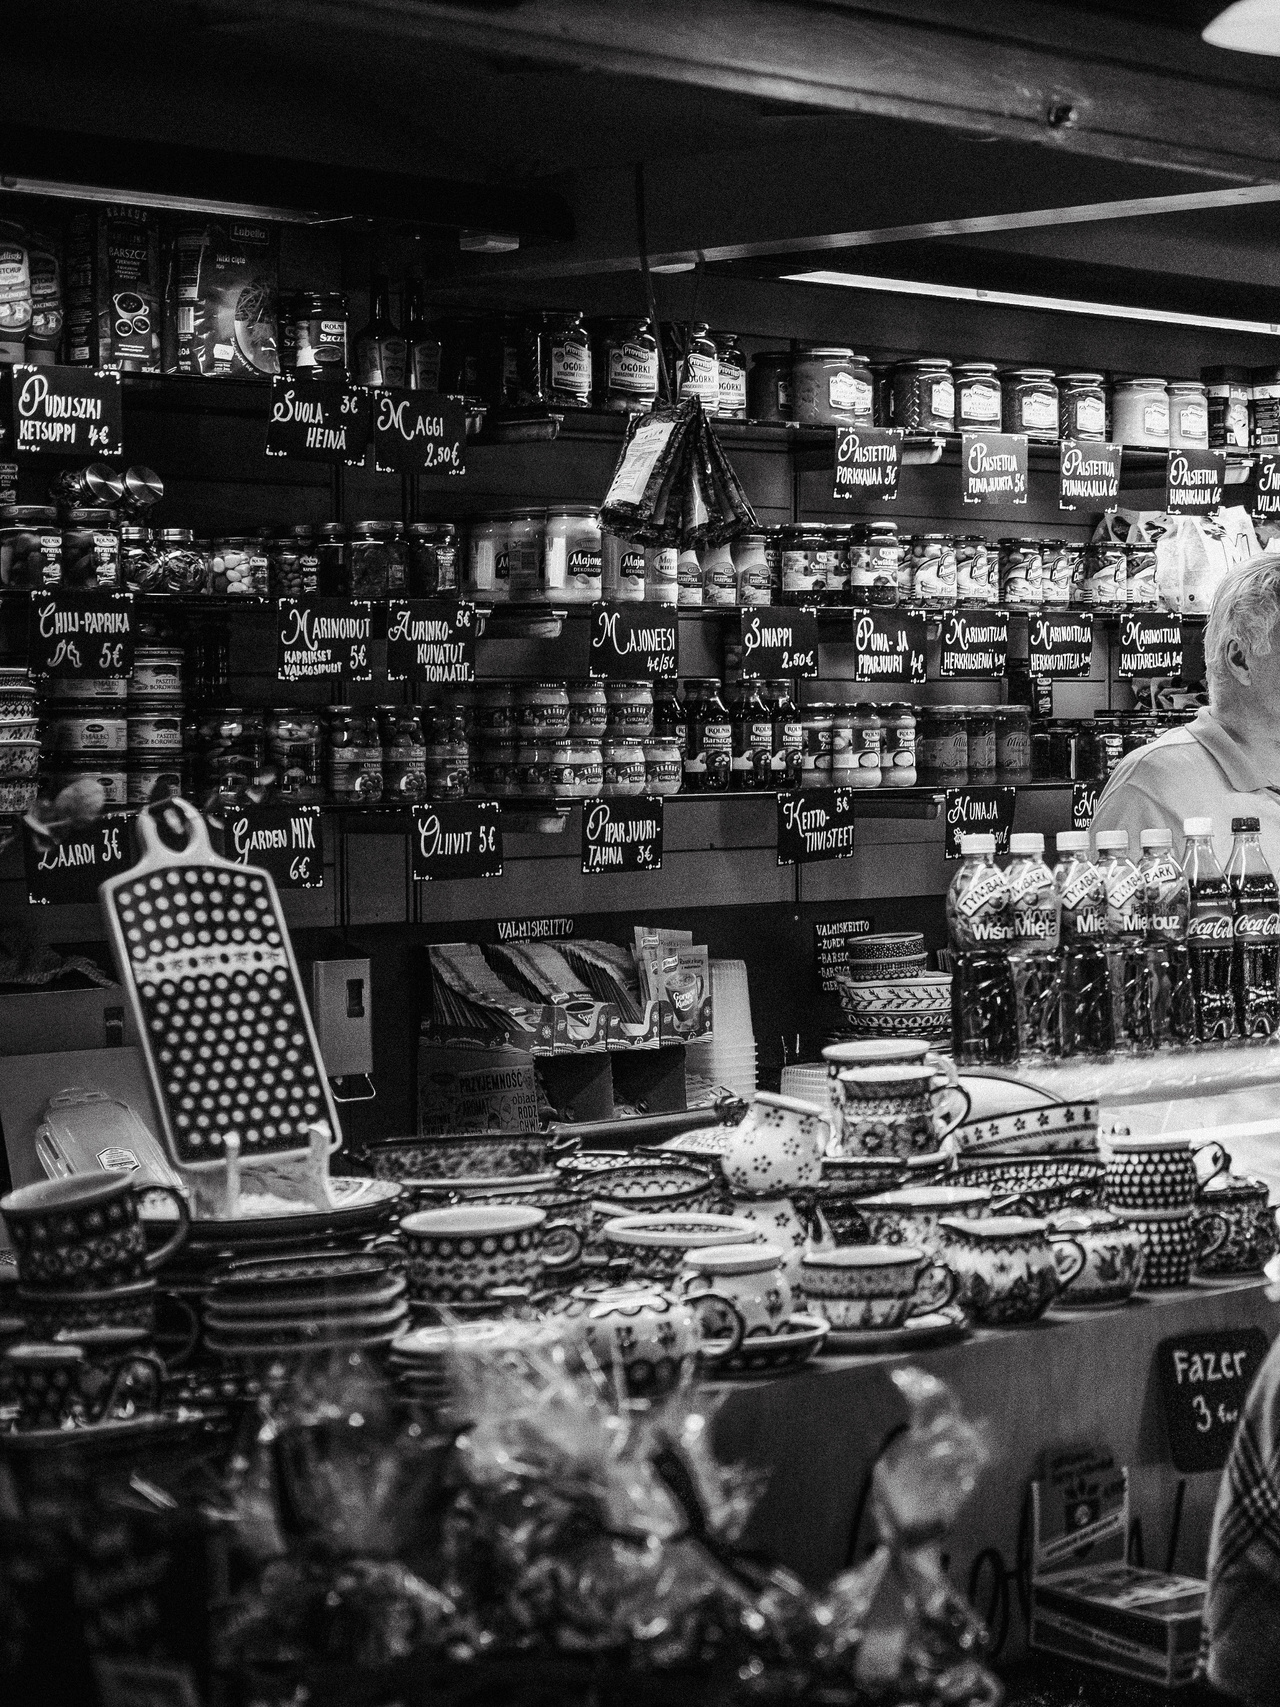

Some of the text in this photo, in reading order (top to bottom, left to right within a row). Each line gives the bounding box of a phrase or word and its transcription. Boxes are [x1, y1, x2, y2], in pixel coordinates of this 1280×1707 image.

[233, 226, 266, 239] Lubella
[109, 247, 147, 261] BARSZCZ
[324, 323, 345, 331] ROLNI
[620, 362, 651, 374] OGÓRKI
[19, 374, 102, 420] PUDLISZKI
[271, 390, 359, 423] SUOLA- 3€
[377, 398, 444, 440] MAGGI
[19, 419, 110, 447] KETSUPPI 4€
[306, 424, 348, 451] HEINÄ
[838, 434, 897, 463] PAISTETTUA
[968, 442, 1018, 474] PAISTETTUA
[836, 465, 898, 486] PORKKANAA 5€
[1062, 449, 1115, 477] PAISTETTUA
[1169, 457, 1218, 486] PAISTETTUA
[968, 473, 1025, 494] PUNAJUURTA 5€
[1062, 478, 1118, 498] PUNAKAALIA 6€
[1169, 487, 1222, 506] HAPANKAALIA 6€
[570, 553, 601, 568] Majone
[38, 602, 130, 638] CHILI-PAPRIKA
[281, 609, 371, 651] MARINOIDUT
[388, 610, 471, 641] AURINKO- 5€
[593, 611, 676, 655] MAJONEESI
[745, 617, 793, 657] SINAPPI
[856, 616, 909, 653] PUNA- JA
[945, 618, 1008, 651] MARINOITUJA
[1030, 620, 1092, 651] MARINOITUJA
[1122, 621, 1182, 652] MARINOITUJA
[99, 642, 124, 668] 5€
[284, 644, 367, 669] KAPRIKSET 5€
[417, 642, 466, 664] KUIVATUT
[646, 653, 675, 673] 4€/5€
[858, 650, 924, 675] PIPARJUURI 4€
[1030, 652, 1080, 672] HERKKUTATTEJA
[1121, 650, 1172, 671] KANTARELLEJA
[284, 661, 343, 676] VALKOSIPULIT
[425, 662, 471, 683] TOMAATIT
[707, 726, 731, 734] ROLNIK
[783, 797, 850, 838] KEITTO- 5€
[947, 795, 999, 824] HUNAJA
[418, 814, 497, 858] OLIIVIT 5€
[586, 805, 661, 843] PIPARJUURI-
[101, 828, 122, 862] 3€
[233, 817, 316, 865] GARDEN MIX
[804, 825, 855, 853] TIIVISTEET
[289, 856, 310, 880] 6€
[588, 845, 654, 866] TAHNA 3€
[1144, 864, 1175, 885] BARK
[961, 872, 1006, 912] TYMBA
[497, 918, 574, 940] VALMISKEITTO
[816, 920, 870, 936] VALMISKEITTO
[972, 921, 1014, 942] Wiśn
[1015, 918, 1058, 940] Mięta
[1076, 914, 1108, 935] Mię
[1123, 914, 1147, 936] Mię
[1187, 915, 1234, 941] Coca-Col
[1234, 912, 1280, 938] Coca-Col
[460, 1068, 523, 1093] PRZYJEMNOŚĆ
[1172, 1350, 1248, 1385] Fazer
[1192, 1395, 1212, 1432] 3
